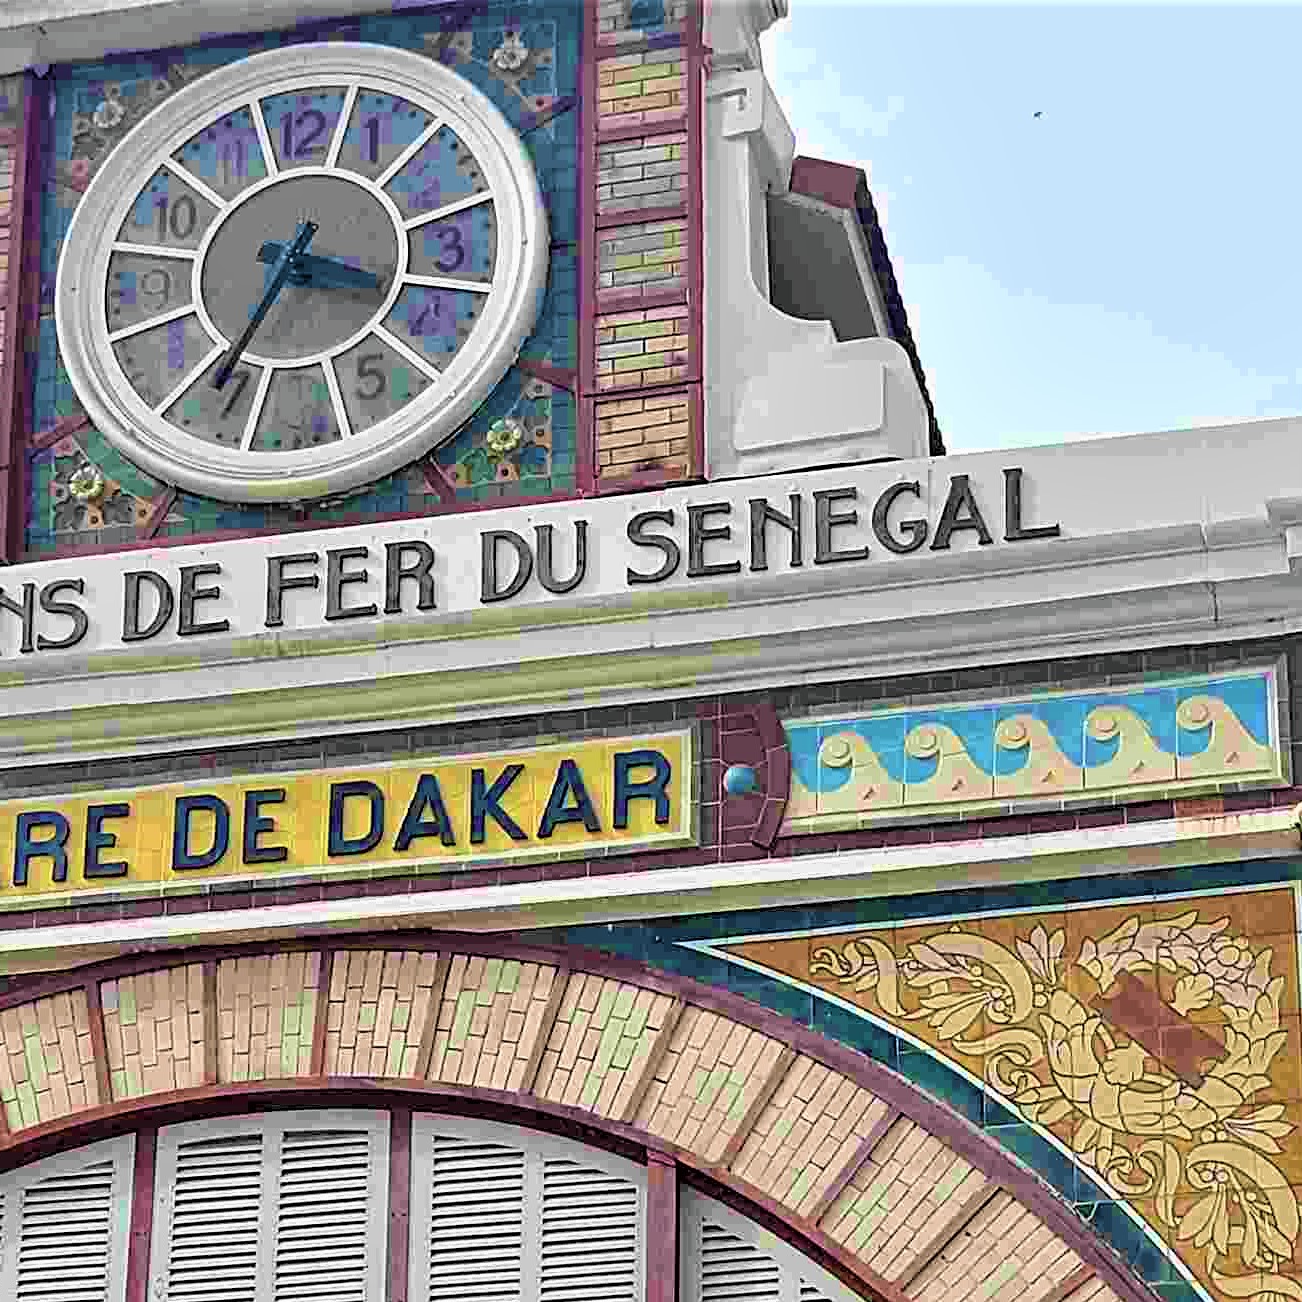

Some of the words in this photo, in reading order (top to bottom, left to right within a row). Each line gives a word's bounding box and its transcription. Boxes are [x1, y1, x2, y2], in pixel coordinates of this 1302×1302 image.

[281, 110, 326, 158] 12
[363, 116, 380, 163] 1
[150, 194, 197, 242] 10
[433, 225, 465, 272] 3
[141, 268, 171, 313] 9
[356, 352, 386, 399] 5
[122, 562, 230, 643] DE
[265, 538, 437, 628] FER
[479, 519, 589, 604] DU
[626, 467, 1061, 585] SENEGAL
[171, 788, 290, 873] DE
[327, 748, 674, 858] DAKAR
